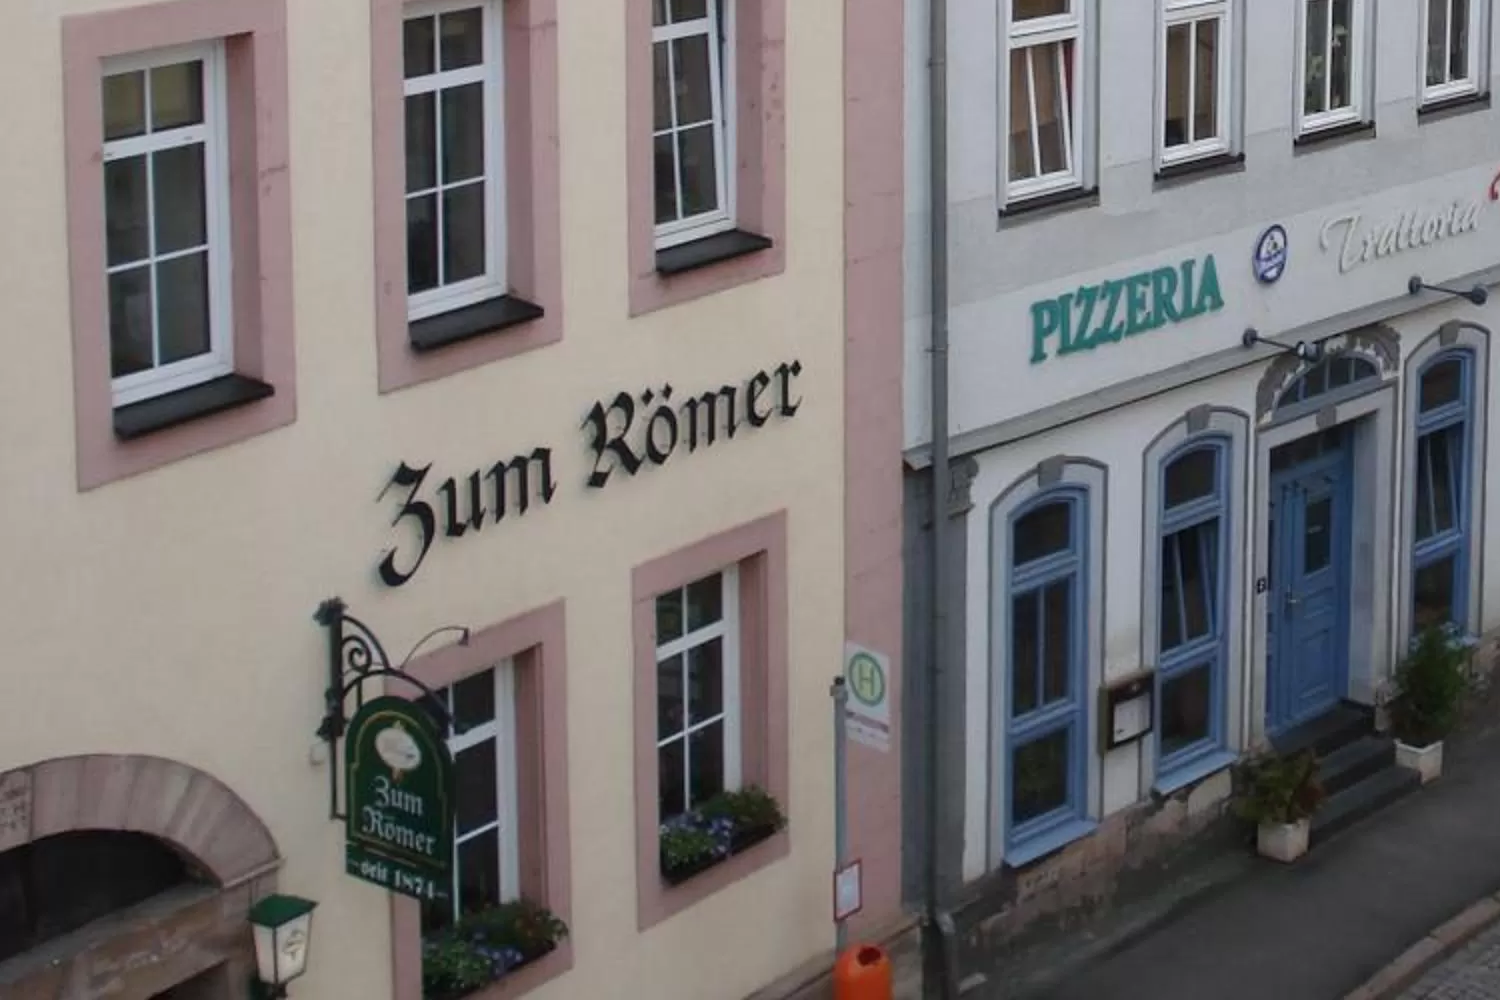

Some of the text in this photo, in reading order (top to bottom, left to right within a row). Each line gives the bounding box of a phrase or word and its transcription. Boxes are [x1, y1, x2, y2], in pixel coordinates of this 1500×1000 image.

[1319, 200, 1482, 275] Trattoria
[1029, 254, 1224, 365] PIZZERIA
[375, 359, 803, 588] Zum Römer
[858, 662, 875, 697] H
[370, 775, 423, 816] Zum
[361, 804, 437, 856] Römer
